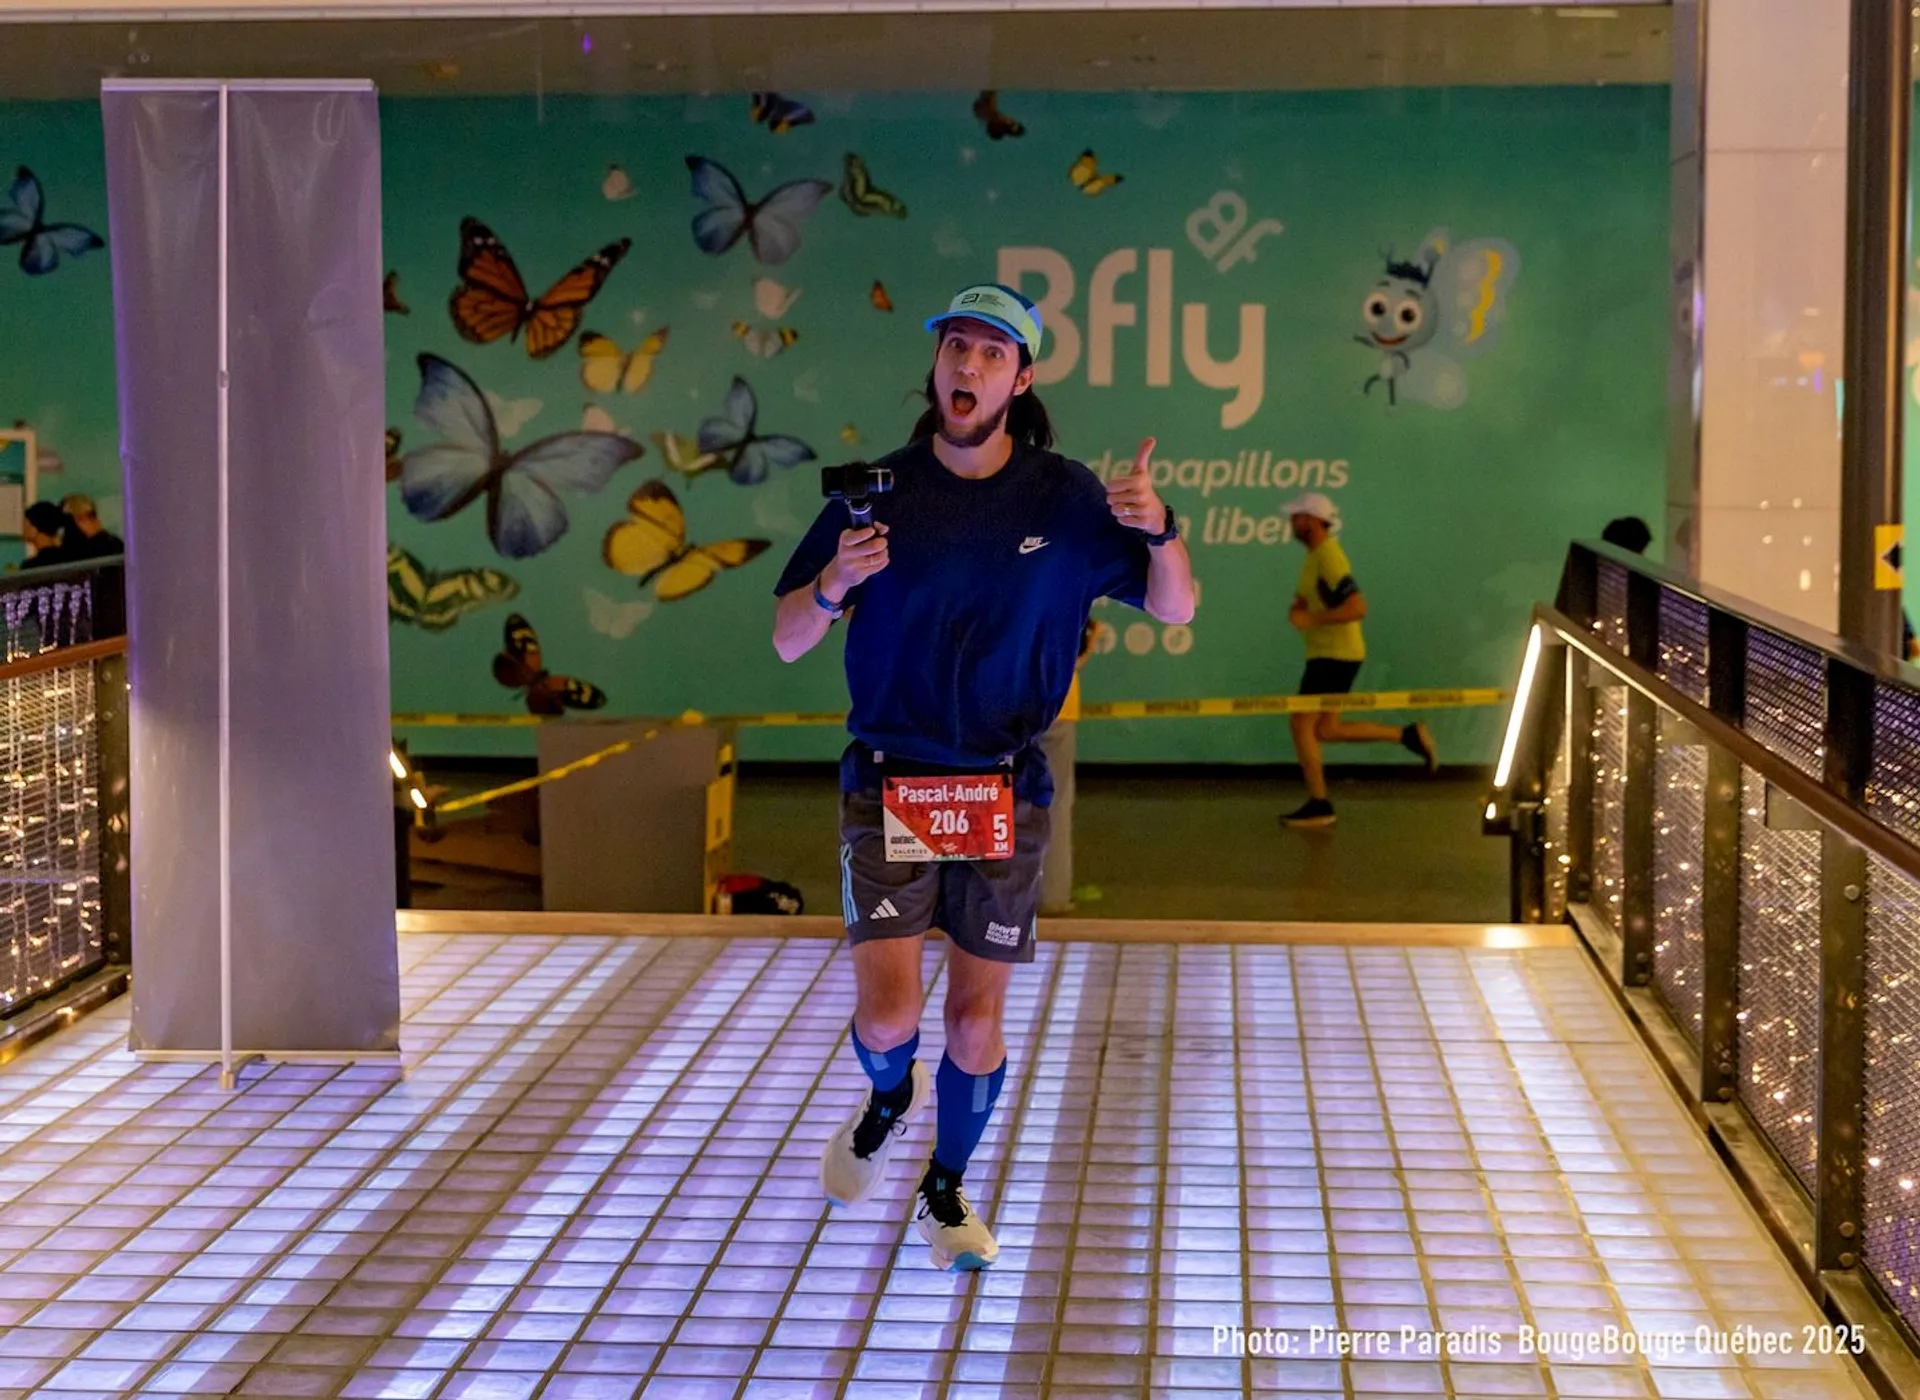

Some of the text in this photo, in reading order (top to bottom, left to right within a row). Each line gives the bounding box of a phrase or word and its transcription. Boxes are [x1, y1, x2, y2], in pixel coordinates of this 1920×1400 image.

[996, 245, 1266, 430] Bfly
[1151, 451, 1349, 497] papillons
[1024, 536, 1044, 547] NIKE
[898, 783, 999, 804] Pascal-André
[929, 809, 970, 835] 206
[993, 813, 1008, 841] 5
[994, 842, 1009, 852] KM
